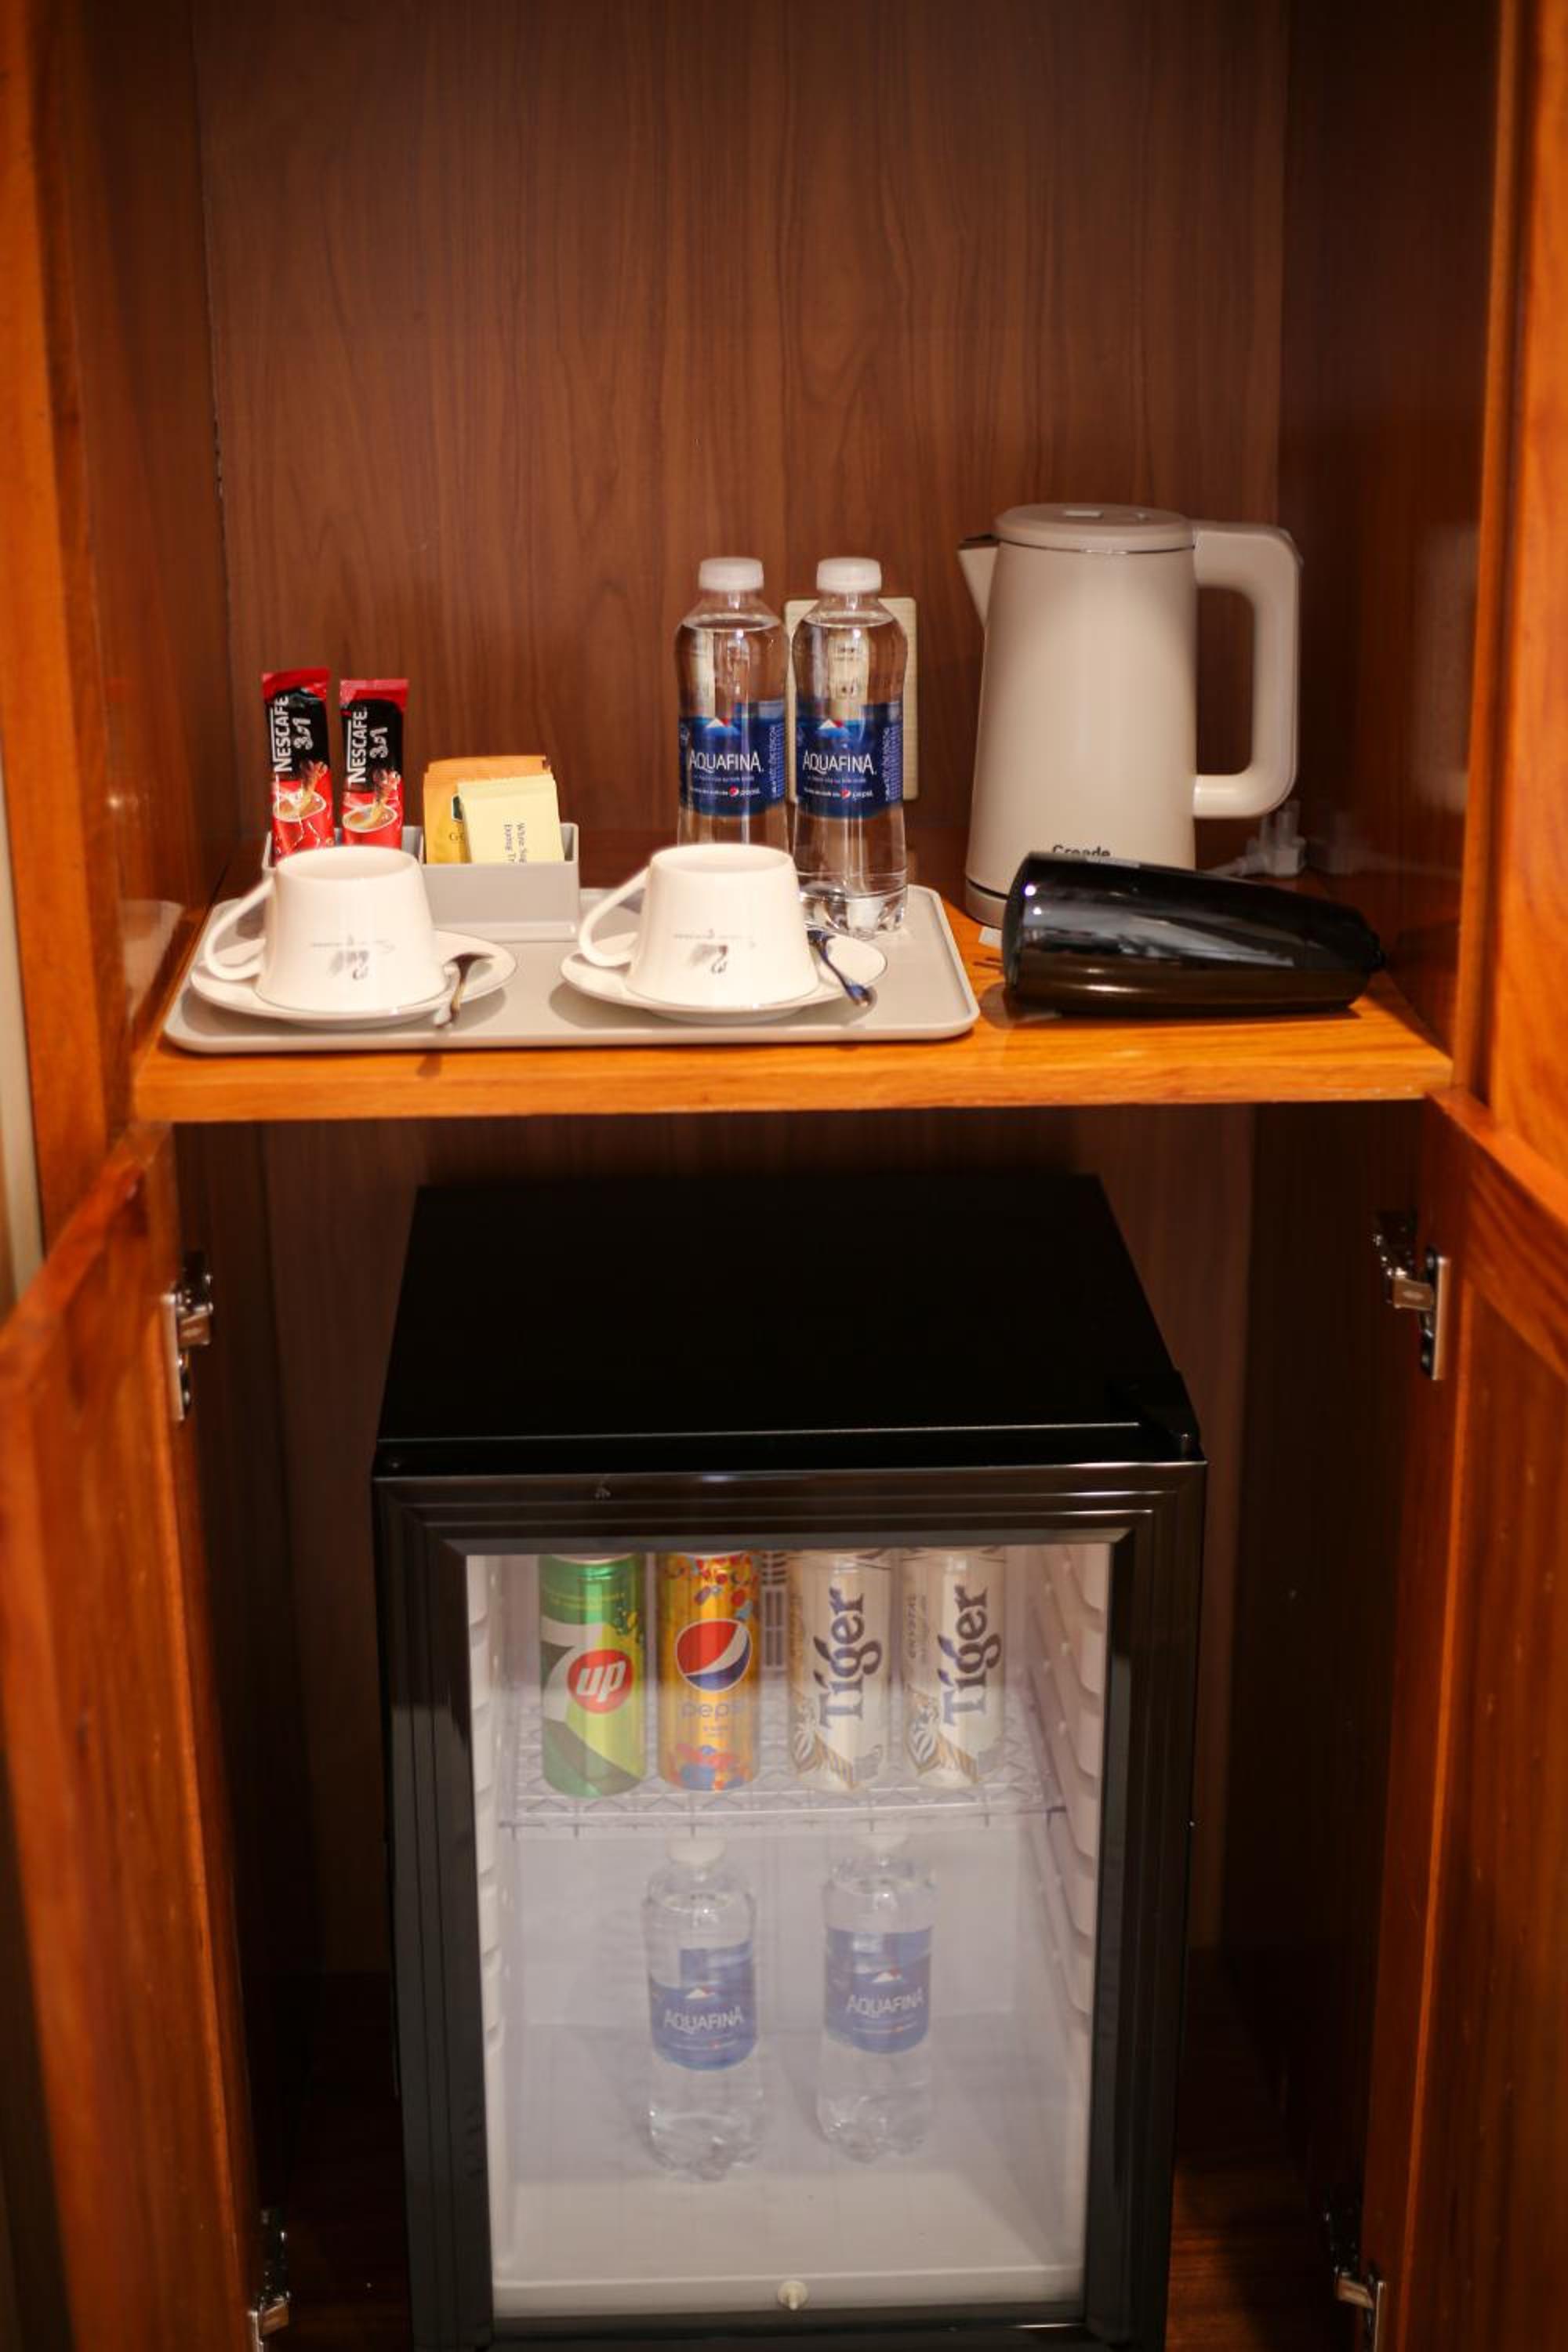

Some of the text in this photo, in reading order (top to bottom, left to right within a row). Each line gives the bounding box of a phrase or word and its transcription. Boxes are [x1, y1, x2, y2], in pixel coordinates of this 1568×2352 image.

[690, 749, 760, 774] AQUAFINA
[803, 750, 874, 775] AQUAFINA
[813, 1586, 882, 1730] Tiger
[937, 1584, 1002, 1726] Tiger
[845, 1987, 925, 2019] AQUAFINA
[664, 2005, 744, 2034] AQUAFINA
